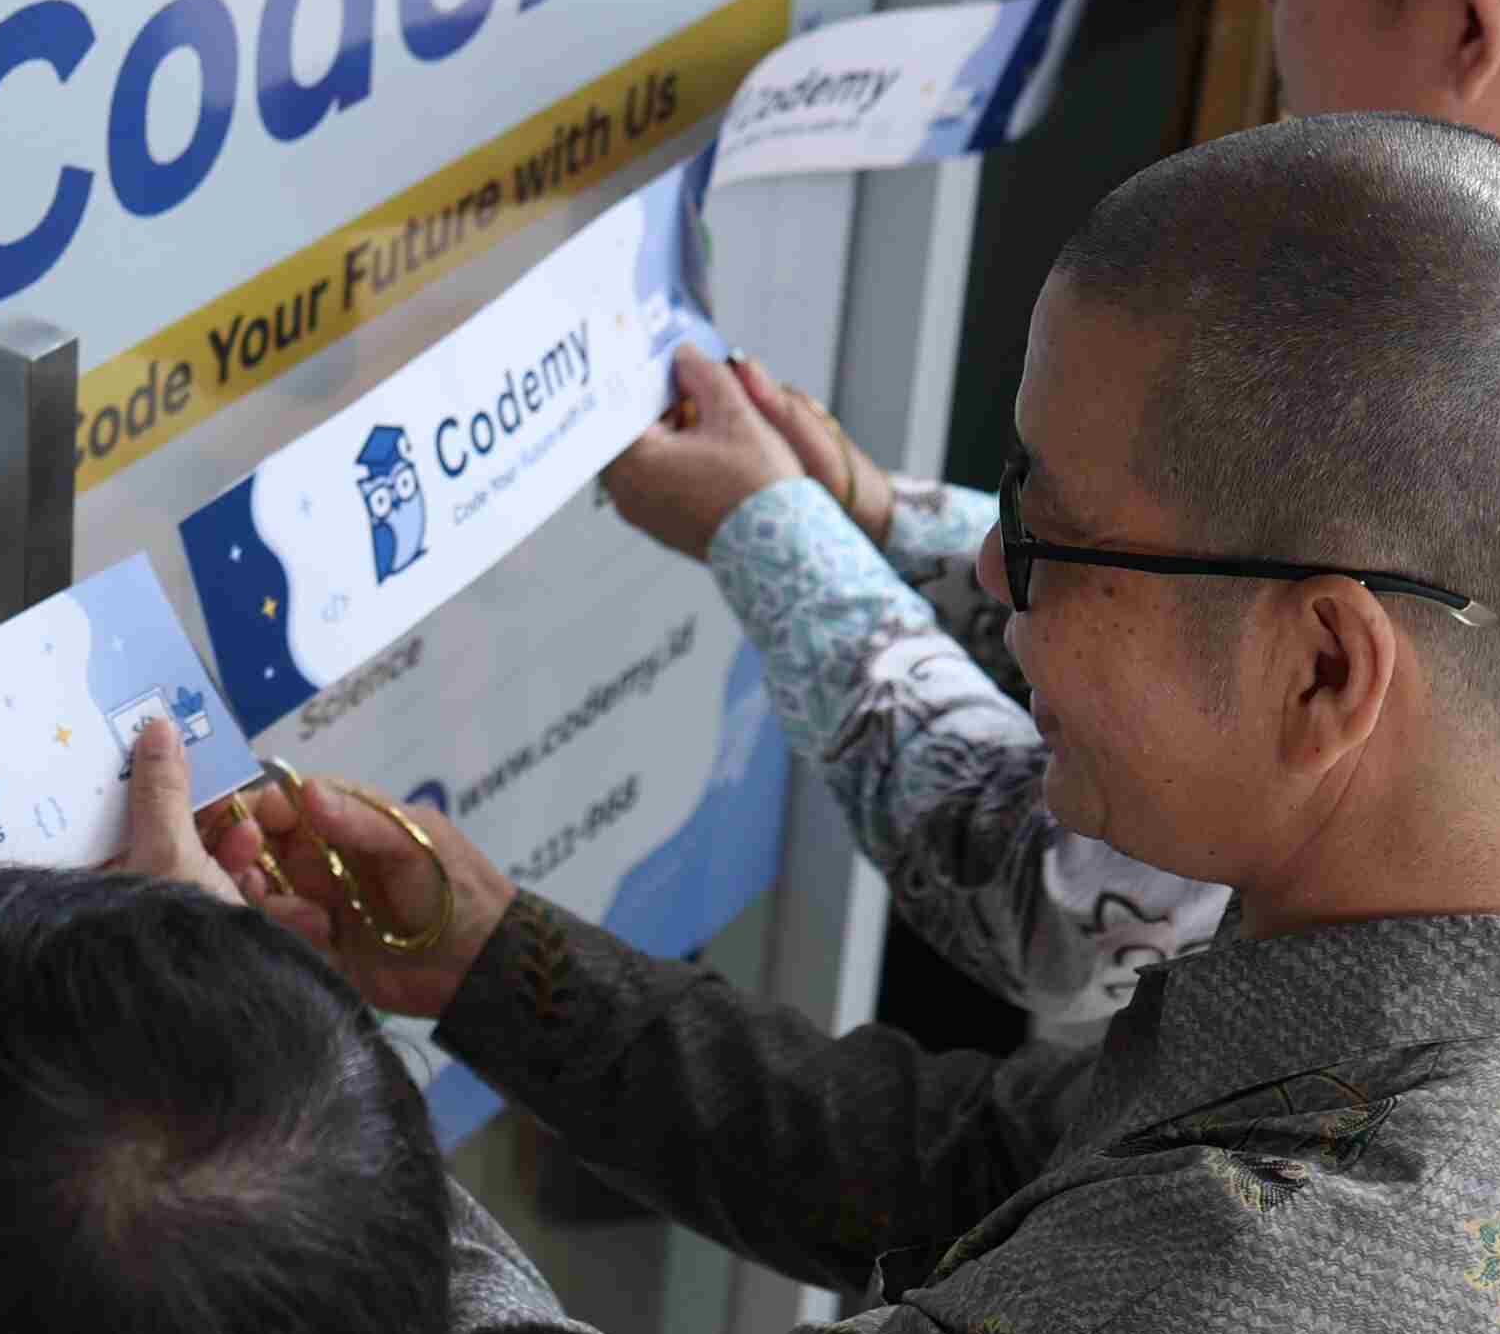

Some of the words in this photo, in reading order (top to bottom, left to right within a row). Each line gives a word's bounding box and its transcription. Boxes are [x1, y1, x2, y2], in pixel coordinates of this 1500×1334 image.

[207, 277, 331, 386] Your
[342, 179, 502, 313] Future
[512, 102, 612, 205] with
[624, 71, 679, 140] Us
[435, 317, 592, 478] Codemy
